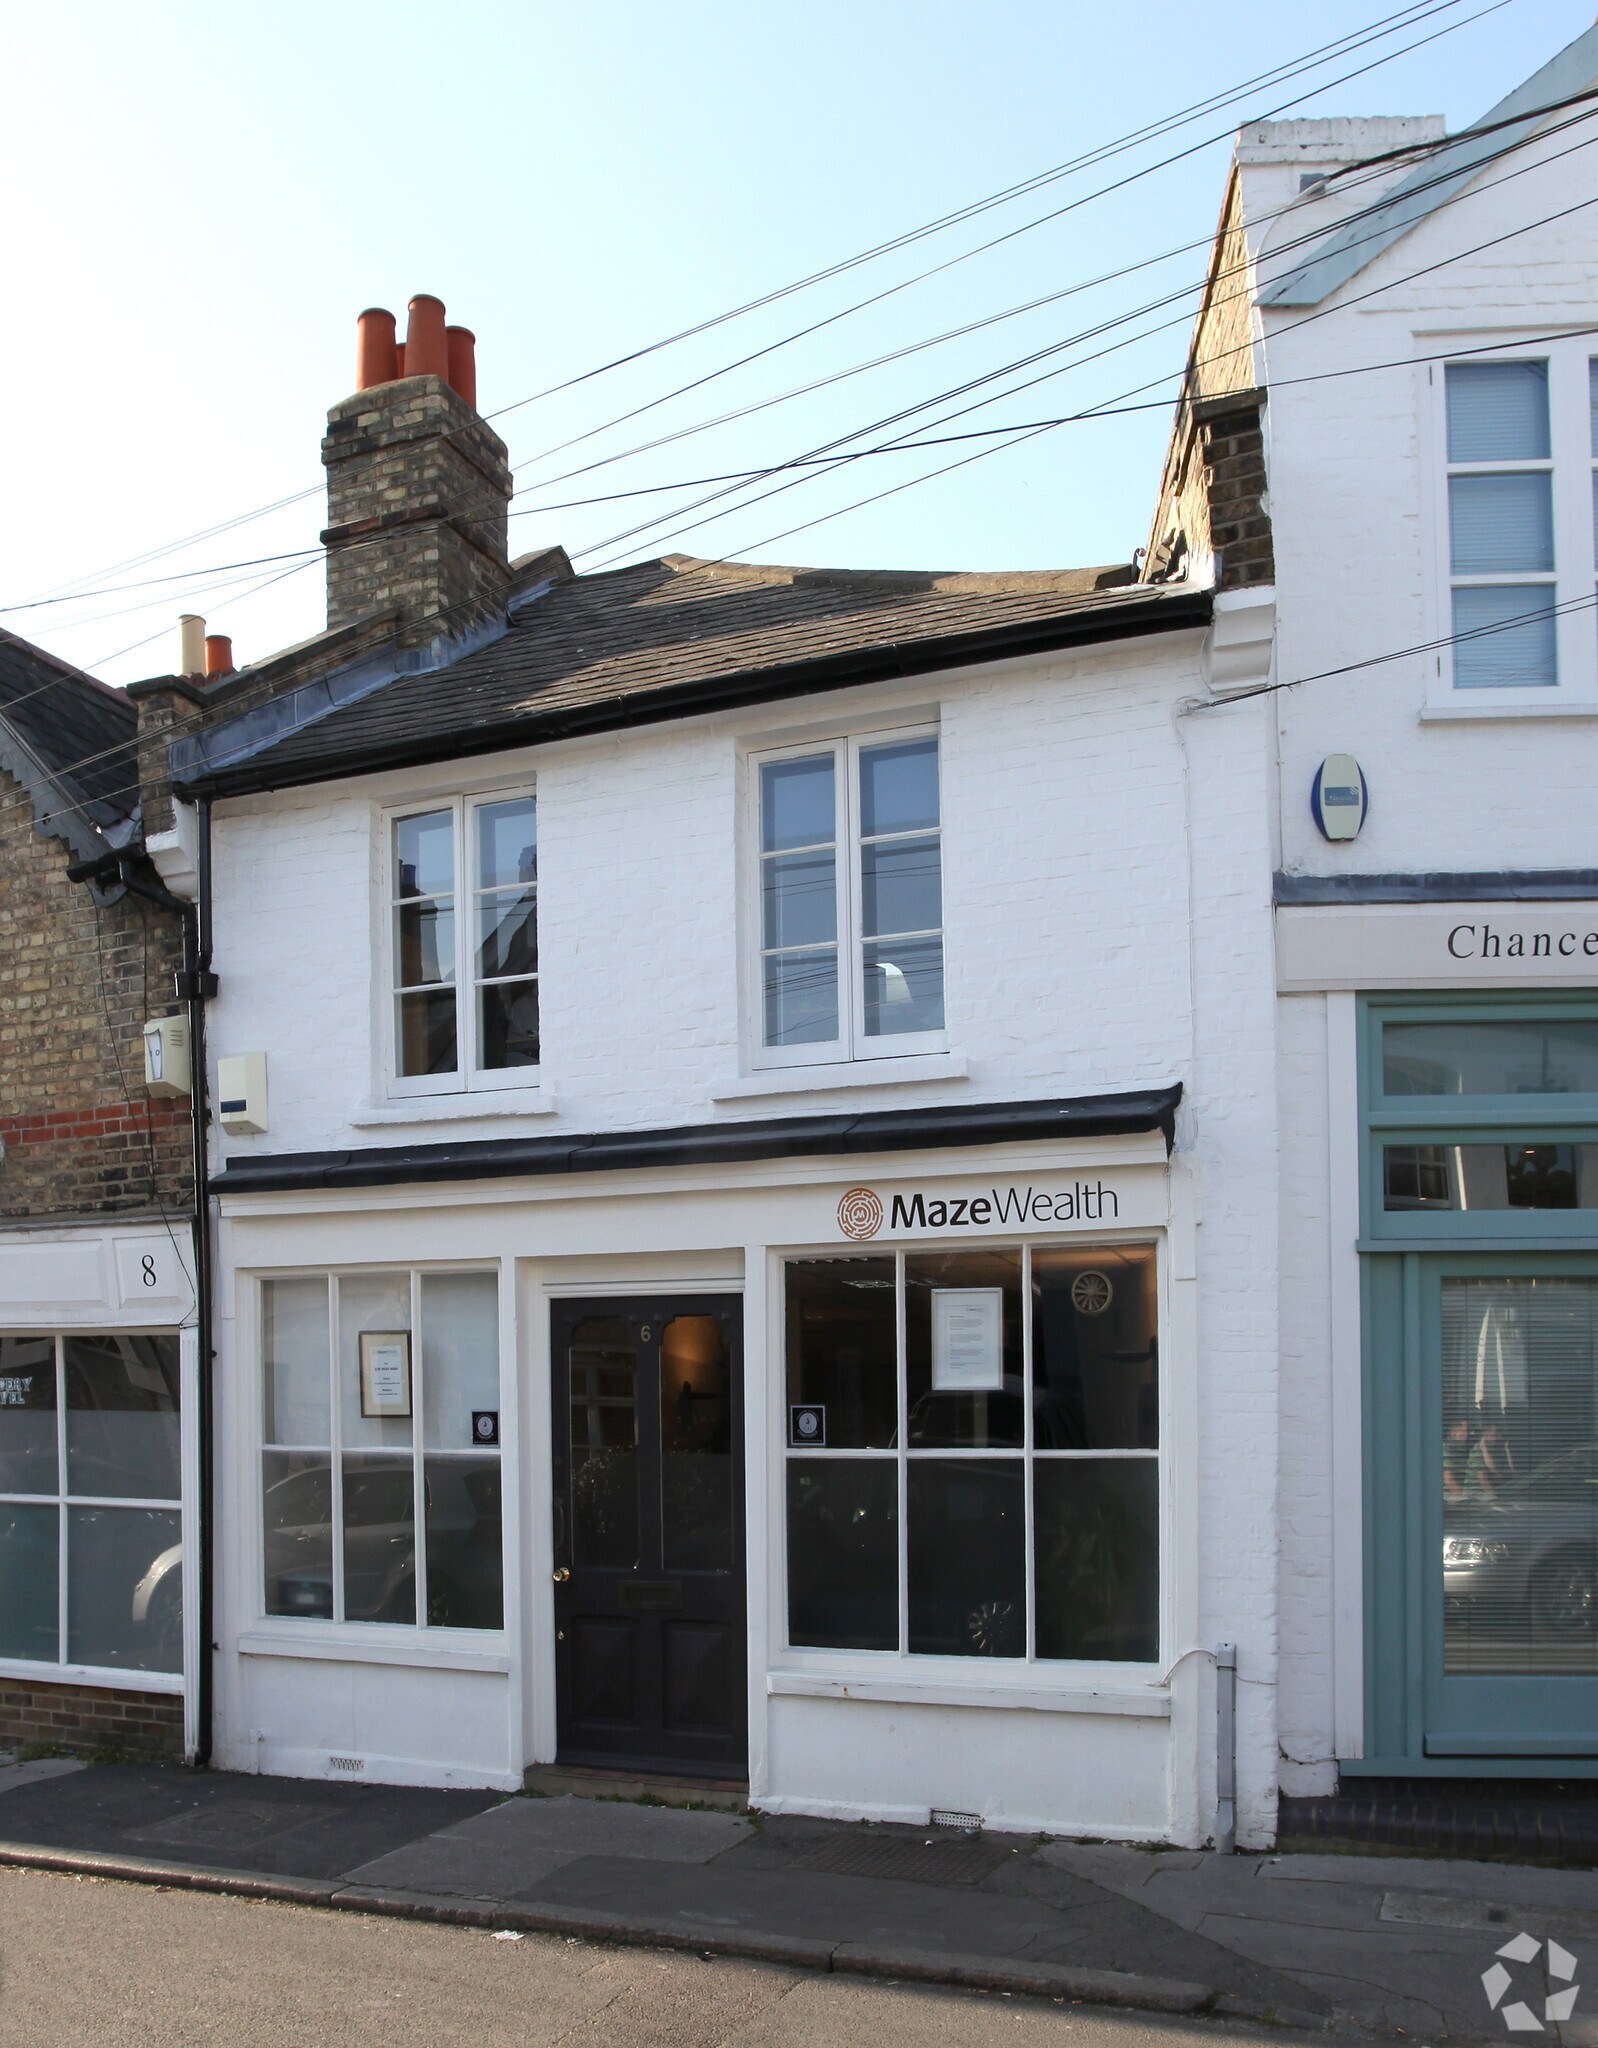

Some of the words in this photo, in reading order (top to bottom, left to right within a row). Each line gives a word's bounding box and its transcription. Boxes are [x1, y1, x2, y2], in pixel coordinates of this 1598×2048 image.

[1447, 924, 1598, 959] Chance
[890, 1181, 1119, 1229] MazeWealth
[141, 1254, 157, 1287] 8
[640, 1325, 652, 1342] 6
